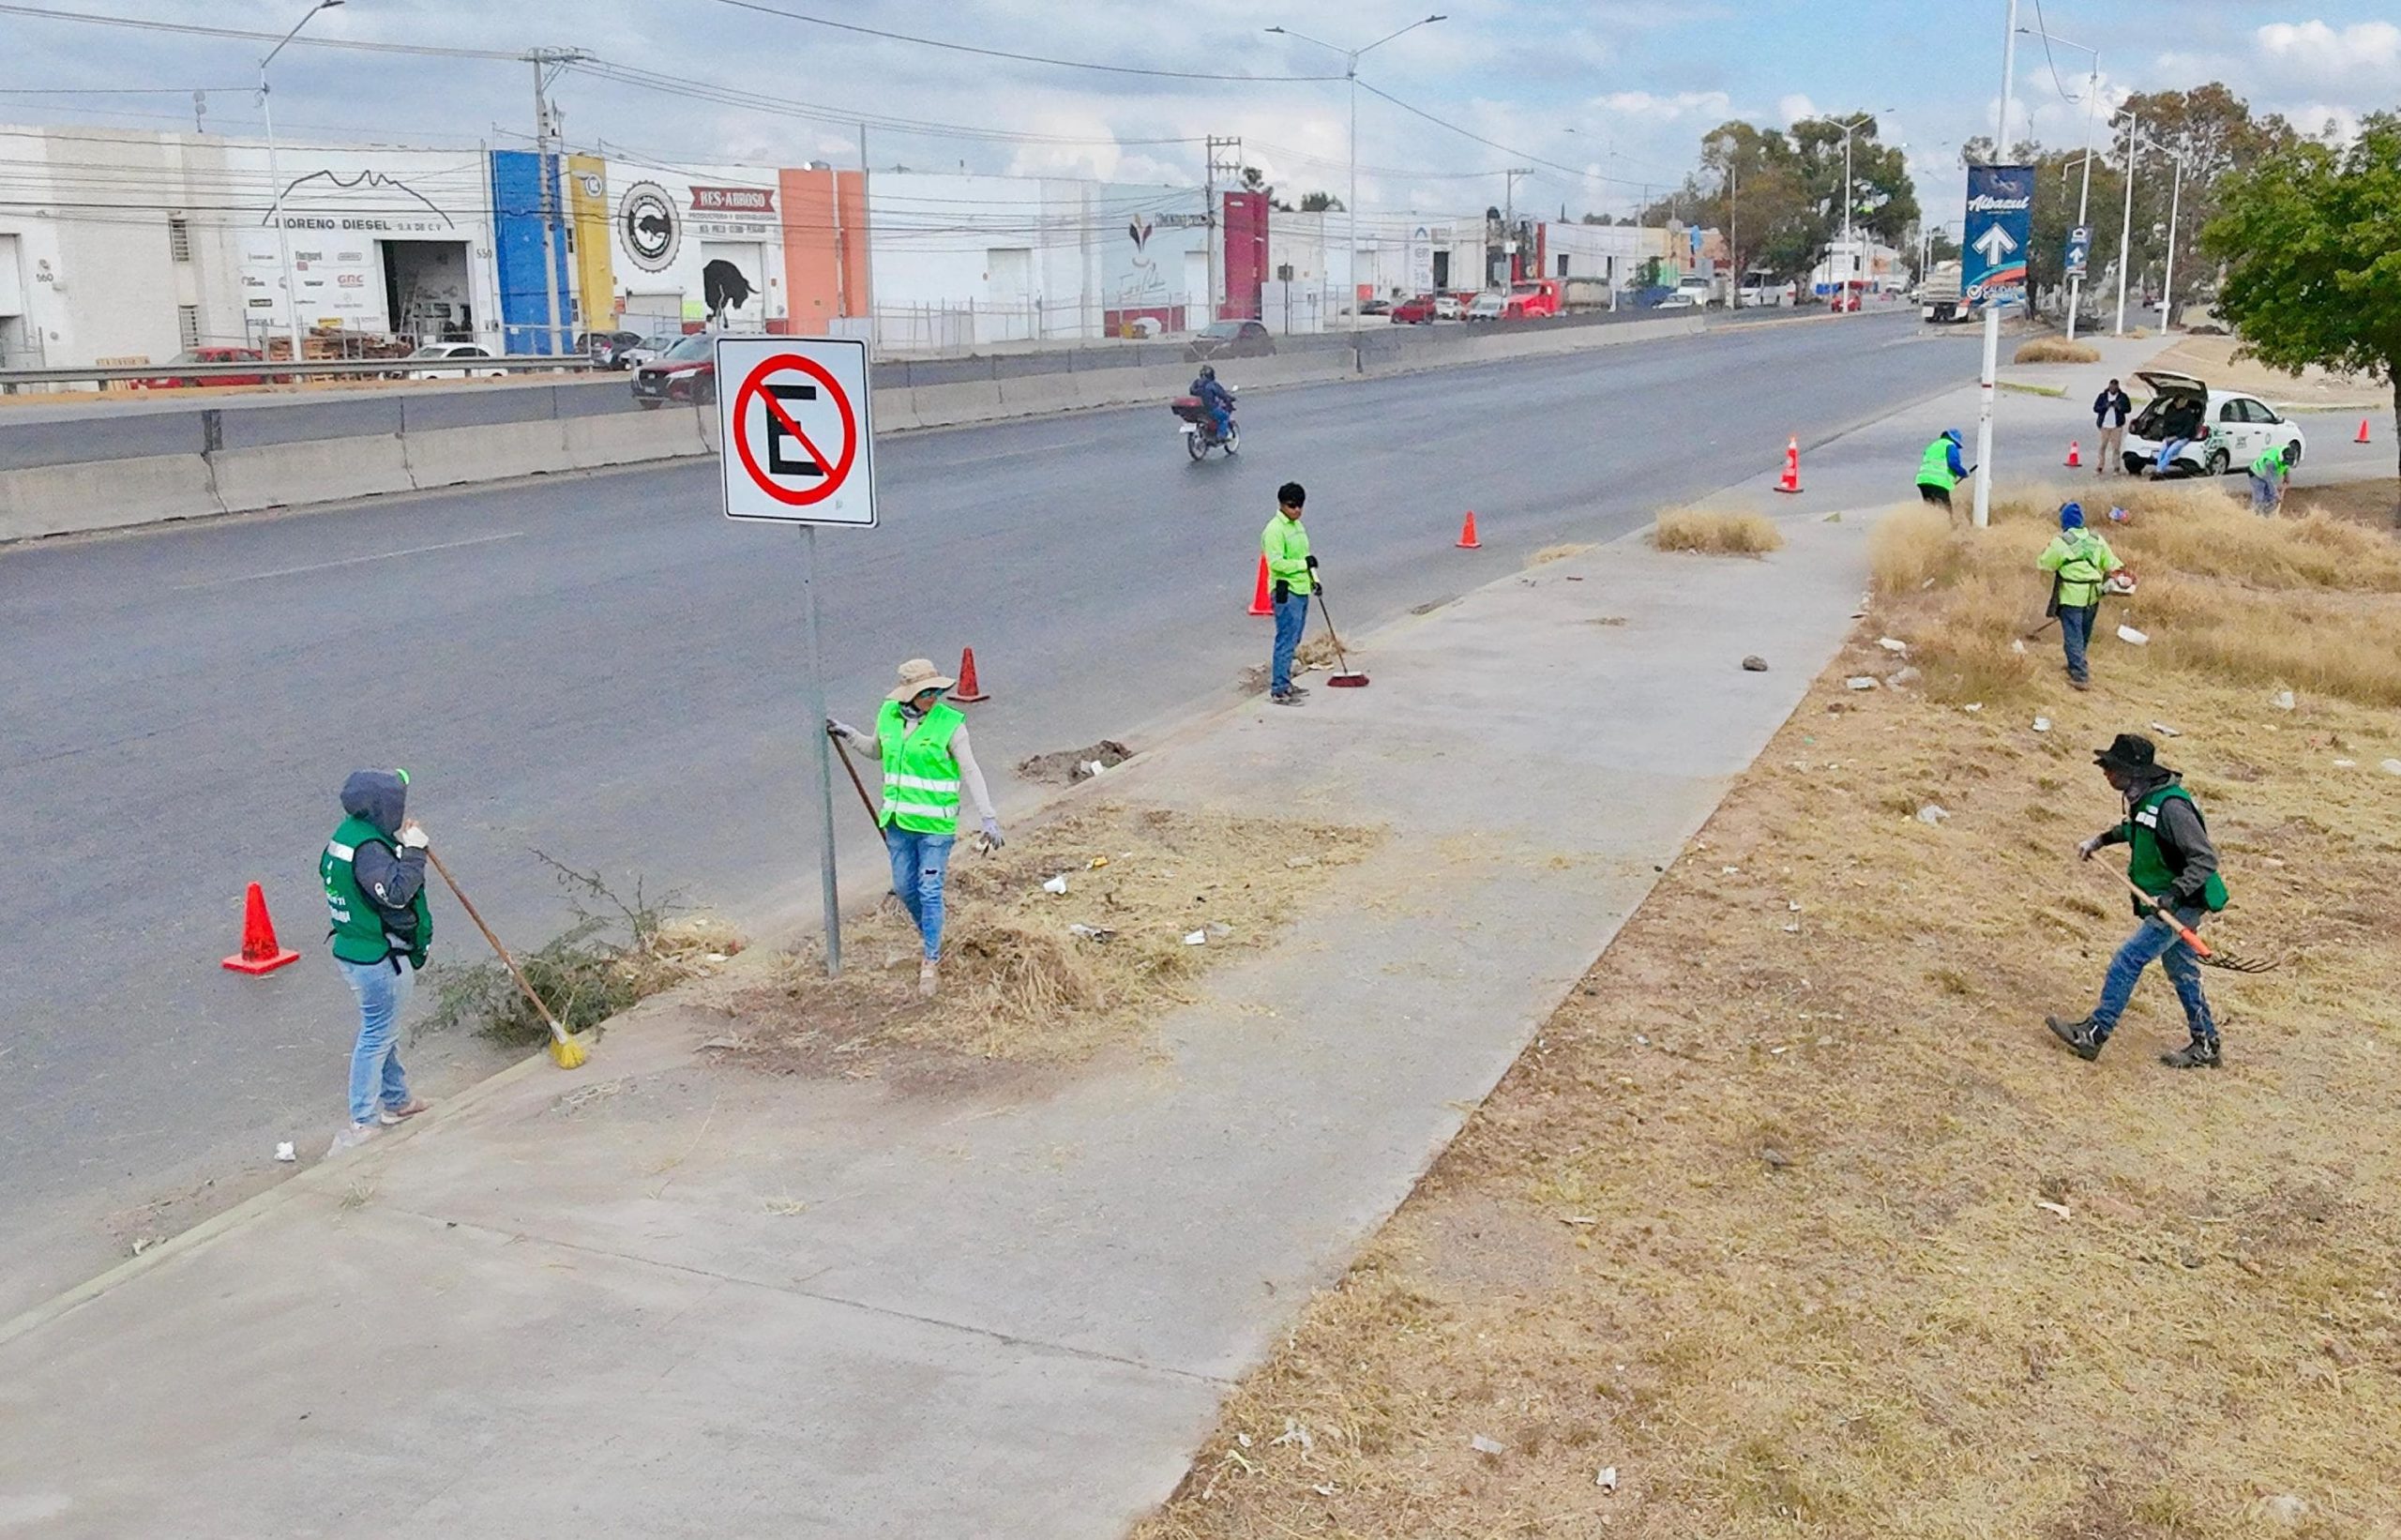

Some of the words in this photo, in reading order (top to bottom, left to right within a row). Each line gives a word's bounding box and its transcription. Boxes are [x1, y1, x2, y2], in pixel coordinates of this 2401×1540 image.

[1968, 194, 2031, 212] Albazul
[341, 219, 392, 230] DIESEL
[337, 274, 365, 283] GRC
[765, 384, 824, 476] E
